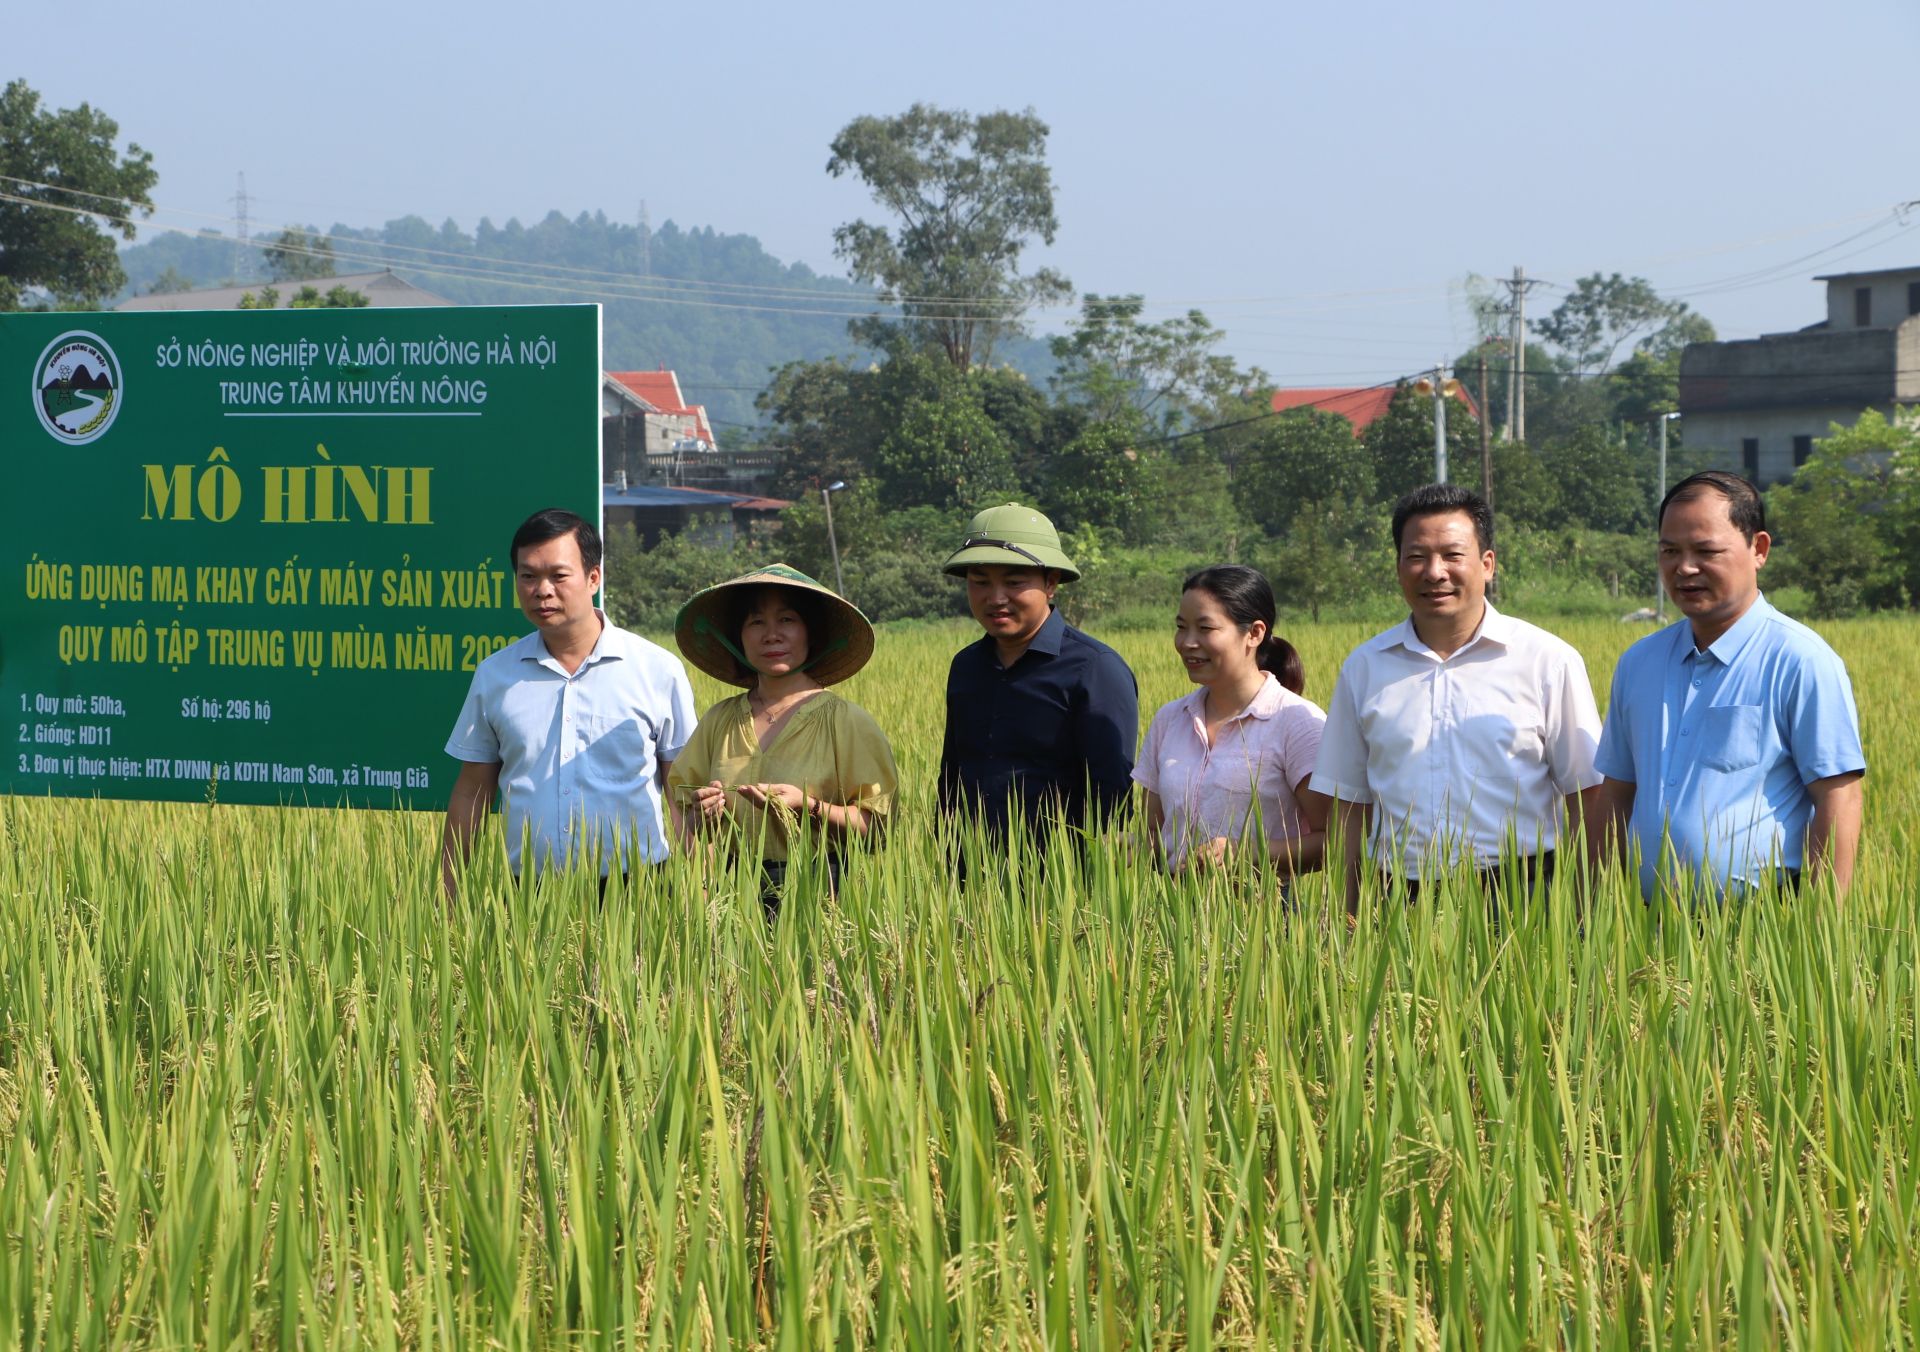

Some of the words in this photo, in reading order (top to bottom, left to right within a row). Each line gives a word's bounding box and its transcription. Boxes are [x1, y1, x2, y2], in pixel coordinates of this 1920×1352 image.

[156, 336, 182, 367] SỞ
[188, 338, 246, 367] NÔNG
[251, 338, 319, 371] NGHIỆP
[324, 335, 351, 366] VÀ
[357, 337, 395, 366] MÔI
[401, 334, 480, 366] TRƯỜNG
[487, 334, 514, 365] HÀ
[520, 335, 557, 370] NỘI
[219, 381, 284, 405] TRUNG
[289, 376, 331, 404] TÂM
[337, 371, 415, 404] KHUYẾN
[421, 375, 488, 404] NÔNG
[140, 446, 242, 523] MÔ
[260, 443, 434, 524] HÌNH
[26, 552, 73, 600] ỨNG
[80, 564, 144, 609] DỤNG
[151, 566, 189, 611] MẠ
[196, 566, 258, 604] KHAY
[265, 554, 312, 605] CẤY
[319, 560, 374, 606] MÁY
[381, 553, 433, 608] SẢN
[441, 557, 505, 609] XUẤT
[58, 624, 104, 665] QUY
[111, 619, 148, 664] MÔ
[155, 619, 199, 673] TẬP
[206, 628, 285, 667] TRUNG
[292, 630, 323, 676] VỤ
[331, 623, 388, 669] MÙA
[395, 625, 453, 671] NĂM
[20, 693, 32, 712] 1.
[35, 693, 59, 715] Quy
[63, 694, 87, 714] mô:
[90, 695, 126, 718] 50ha,
[181, 695, 200, 718] Số
[202, 698, 223, 723] hộ:
[226, 699, 251, 720] 296
[254, 700, 271, 725] hộ
[19, 723, 31, 743] 2.
[35, 721, 76, 746] Giống:
[79, 725, 111, 746] HD11
[18, 753, 31, 773] 3.
[34, 753, 59, 774] Đơn
[62, 755, 74, 779] vị
[78, 755, 106, 780] thực
[109, 756, 142, 781] hiện:
[145, 758, 171, 779] HTX
[174, 759, 211, 780] DVNN
[234, 761, 269, 783] KDTH
[272, 763, 304, 784] Nam
[308, 764, 338, 788] Sơn,
[342, 763, 359, 786] xã
[363, 765, 401, 790] Trung
[405, 765, 429, 789] Giã
